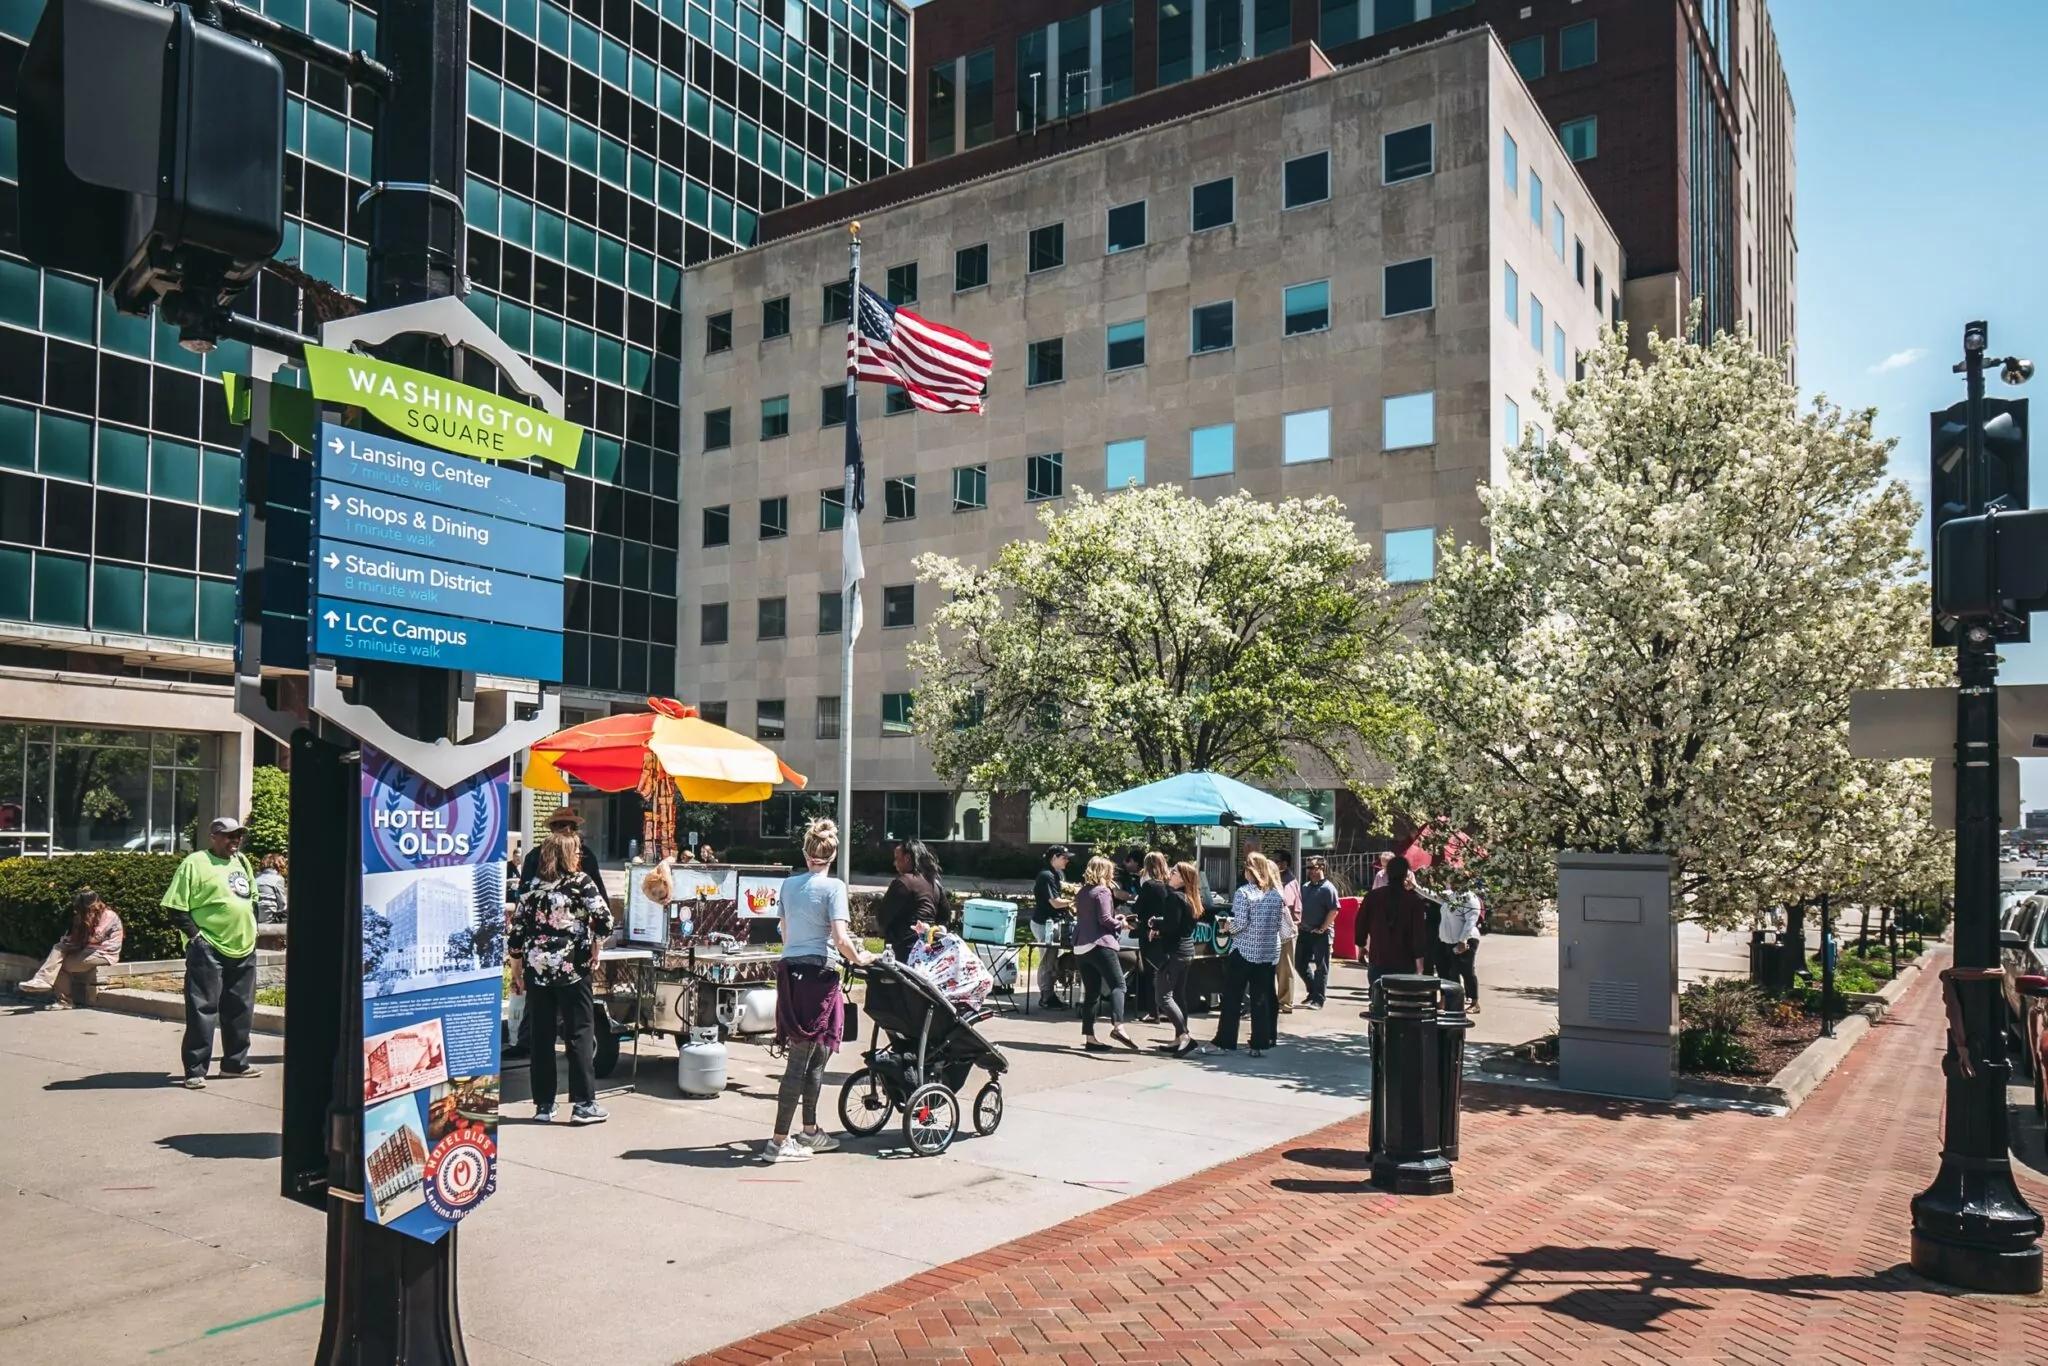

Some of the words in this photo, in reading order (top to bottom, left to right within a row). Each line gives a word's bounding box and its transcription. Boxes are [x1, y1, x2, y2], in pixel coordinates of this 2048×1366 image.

[348, 367, 553, 447] WASHINGTON
[407, 409, 504, 451] SQUARE
[350, 440, 426, 477] Lansing
[431, 460, 492, 489] Center
[350, 462, 357, 474] 7
[362, 465, 409, 487] minute
[414, 478, 443, 493] walk
[345, 518, 350, 531] 1
[354, 522, 401, 541] minute
[406, 533, 436, 547] walk
[346, 497, 408, 526] Shops
[413, 511, 427, 530] &
[432, 515, 489, 545] Dining
[345, 554, 425, 584] Stadium
[430, 568, 493, 596] District
[345, 576, 354, 589] 8
[358, 579, 405, 597] minute
[410, 589, 439, 602] walk
[345, 612, 387, 635] LCC
[393, 619, 467, 646] Campus
[345, 634, 354, 648] 5
[358, 637, 407, 654] minute
[410, 645, 441, 659] walk
[374, 809, 447, 829] HOTEL
[398, 832, 470, 855] OLDS
[427, 1133, 461, 1168] HOTEL
[464, 1130, 492, 1150] OLDS
